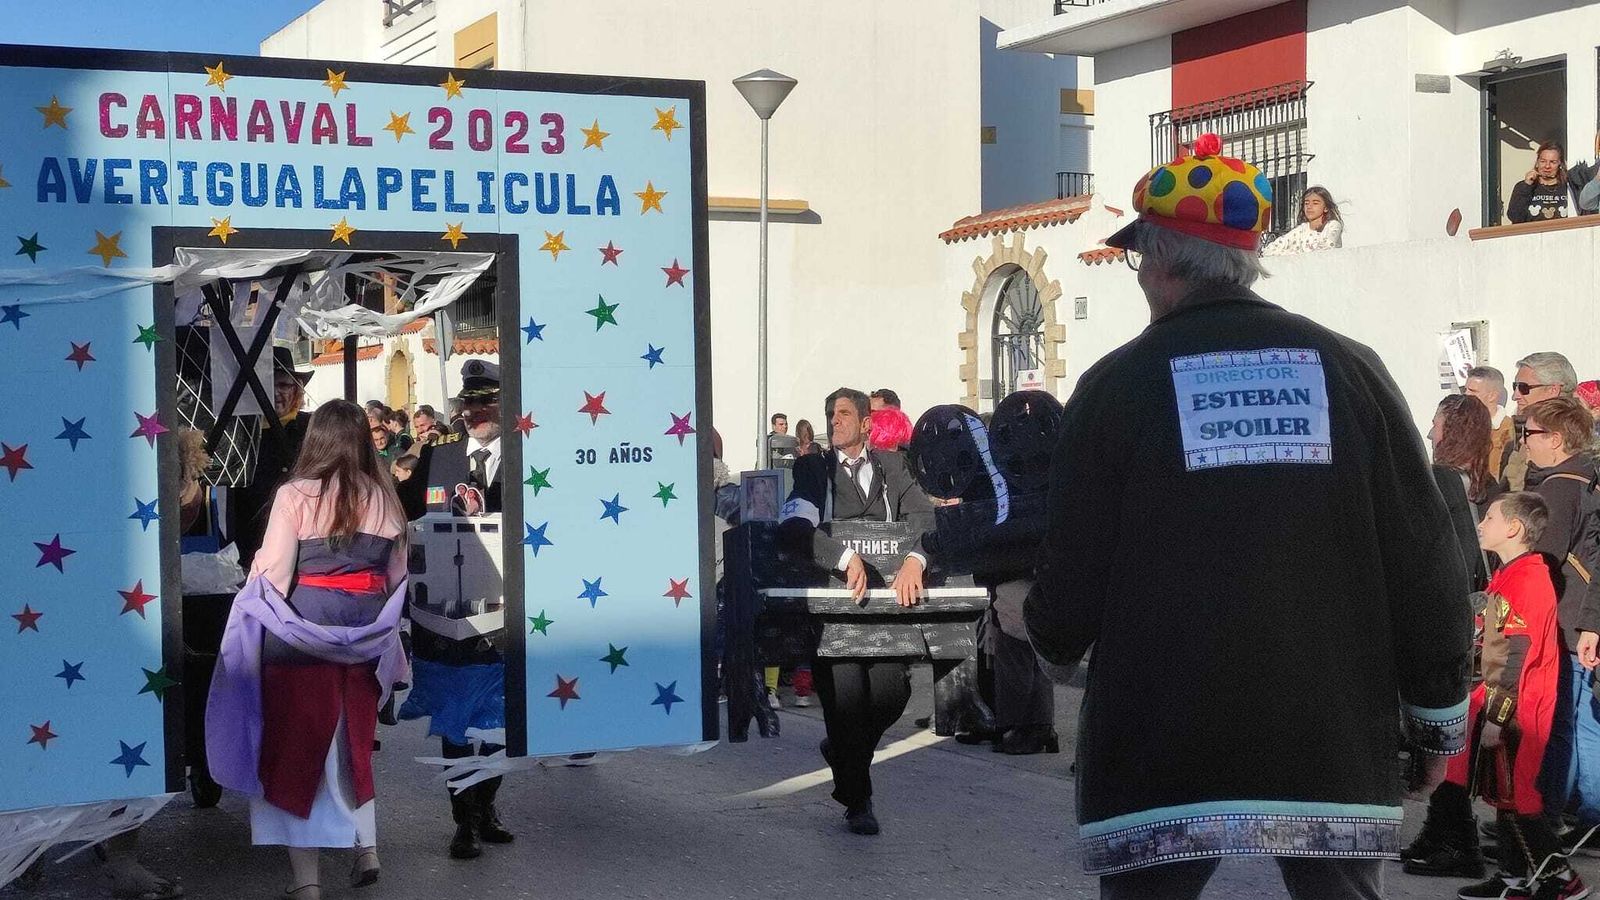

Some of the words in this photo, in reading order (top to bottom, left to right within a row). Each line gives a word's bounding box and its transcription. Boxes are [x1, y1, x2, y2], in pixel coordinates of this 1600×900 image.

[99, 92, 373, 147] CARNAVAL
[428, 106, 566, 155] 2023
[1195, 366, 1300, 385] DIRECTOR:
[1191, 387, 1311, 411] ESTEBAN
[1200, 417, 1312, 441] SPOILER
[575, 448, 597, 465] 30
[608, 442, 653, 464] AÑOS
